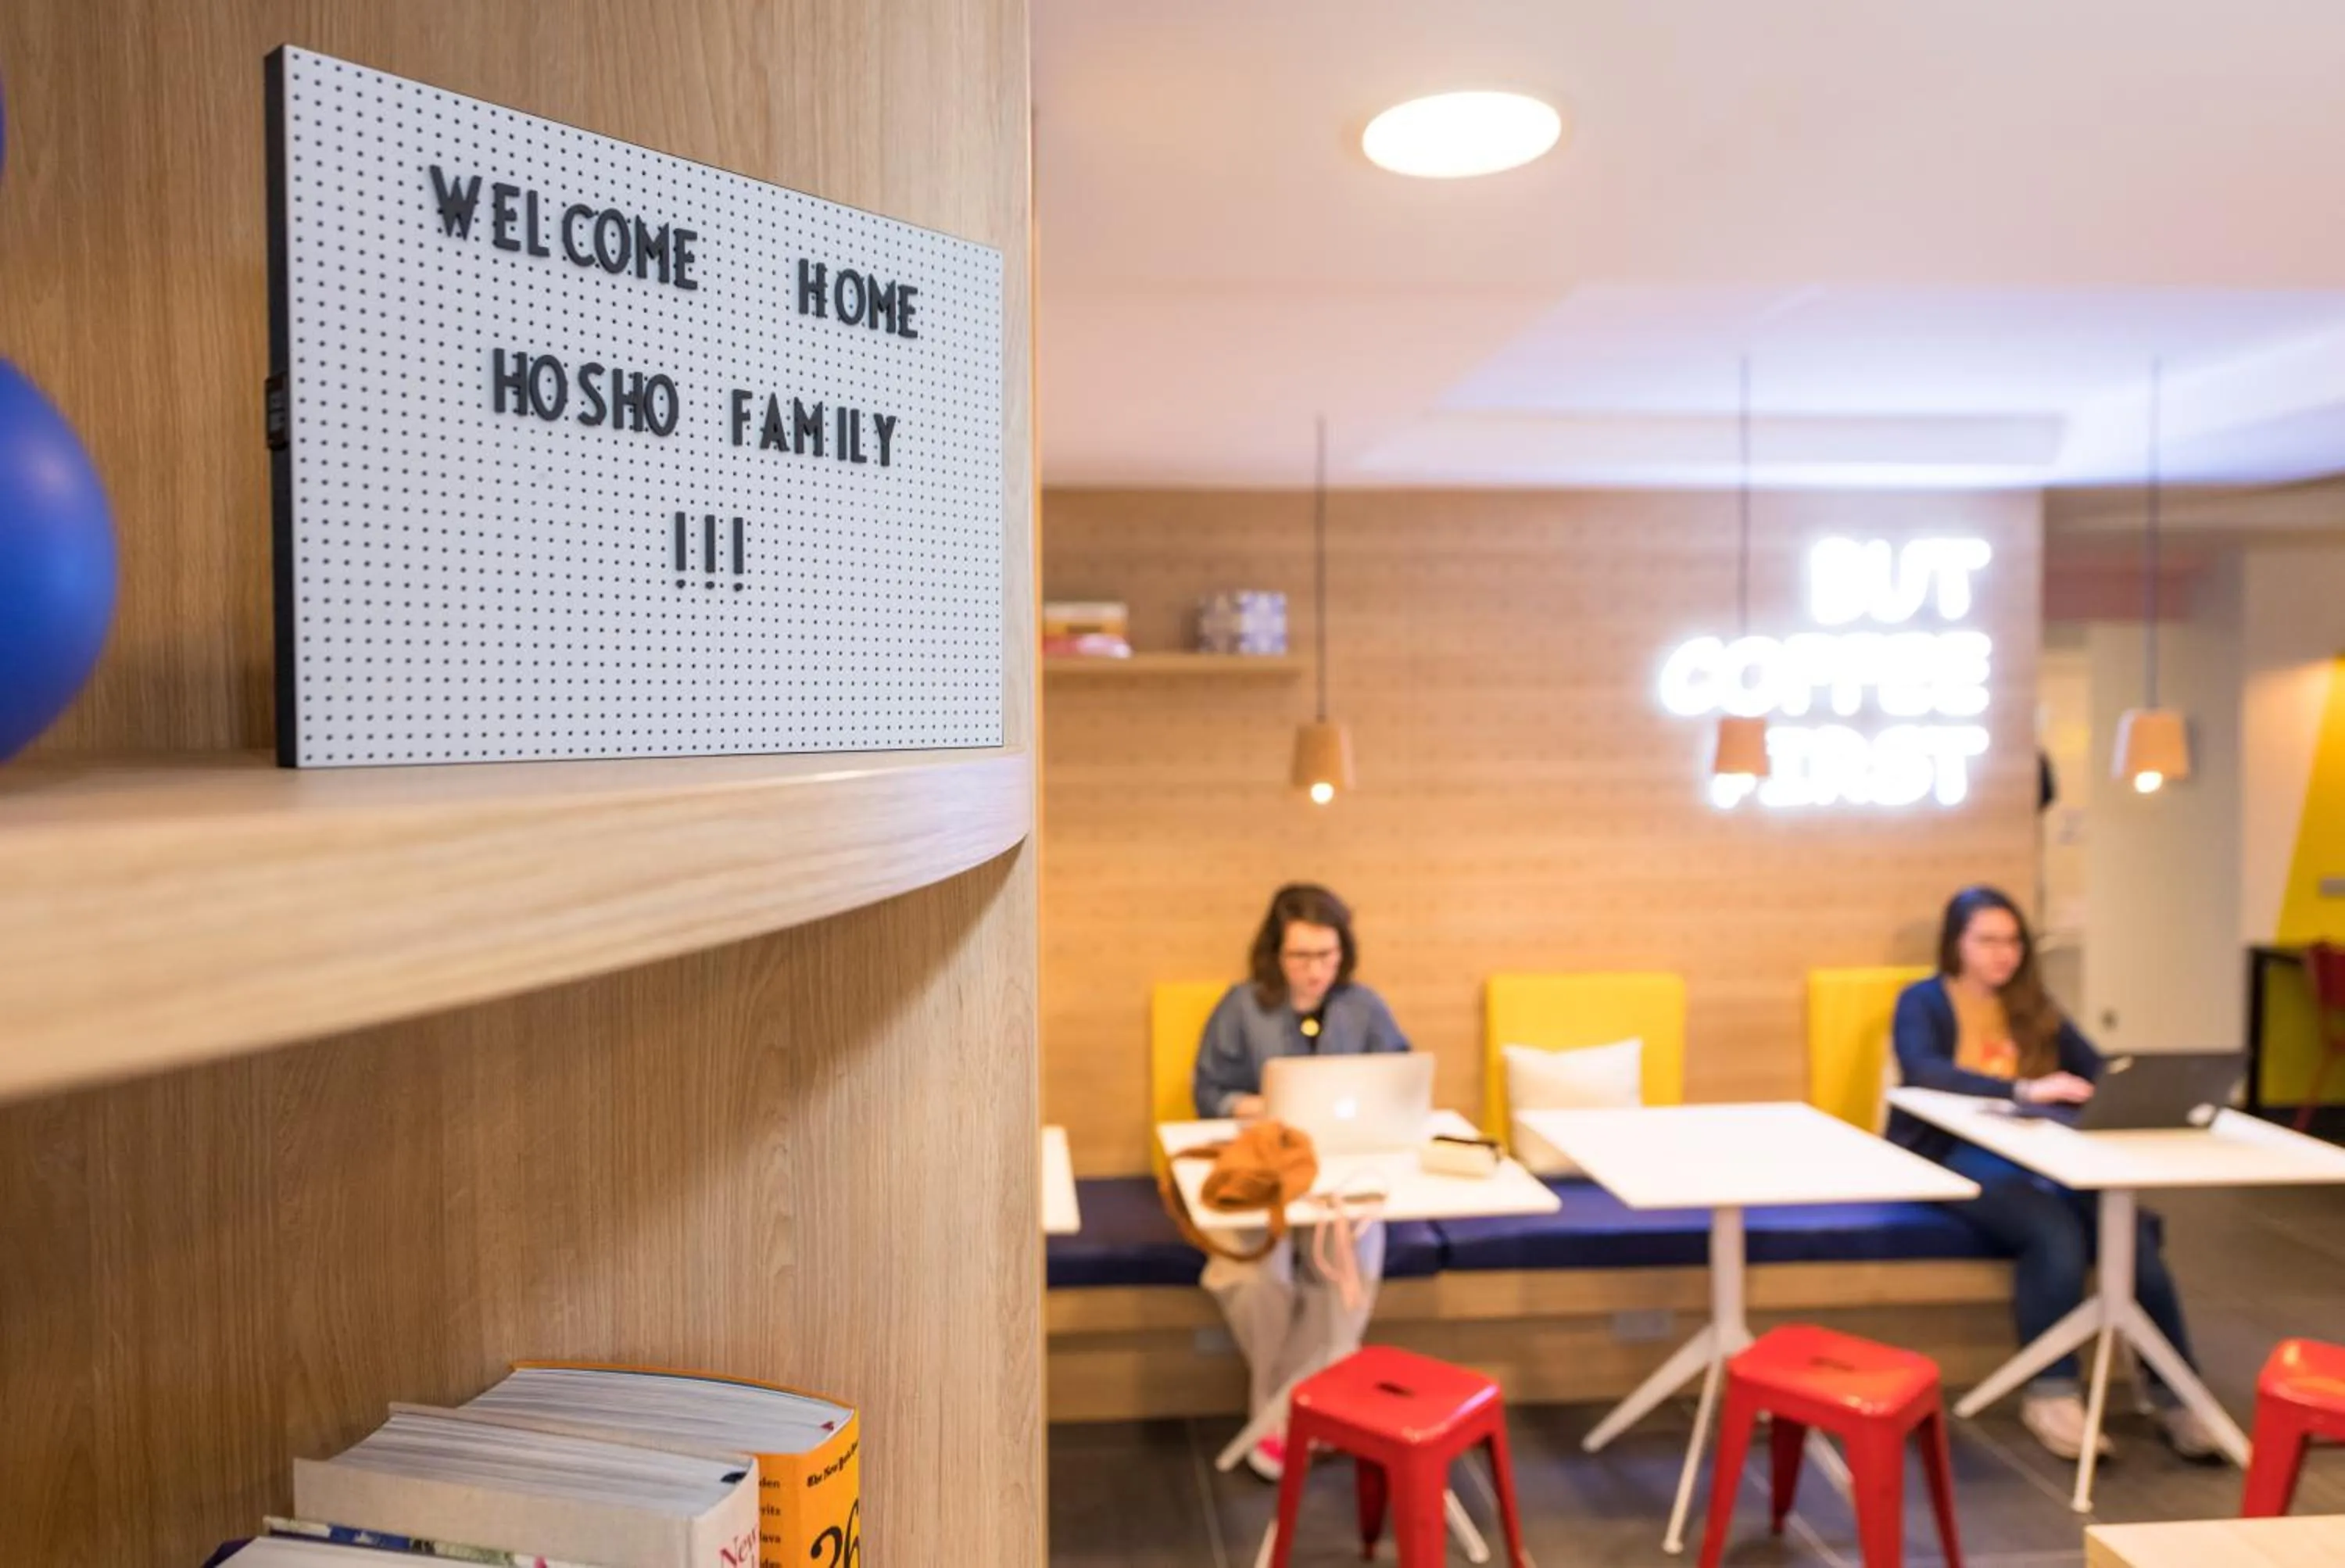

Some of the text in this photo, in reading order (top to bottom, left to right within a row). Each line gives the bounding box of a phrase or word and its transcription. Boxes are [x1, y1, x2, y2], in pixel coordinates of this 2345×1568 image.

[429, 164, 918, 338] WELCOME HOME
[493, 347, 897, 467] HOSHO FAMILY
[675, 511, 744, 592] !!!
[1809, 536, 1991, 625] BUT
[1659, 632, 1991, 717] COFFEE
